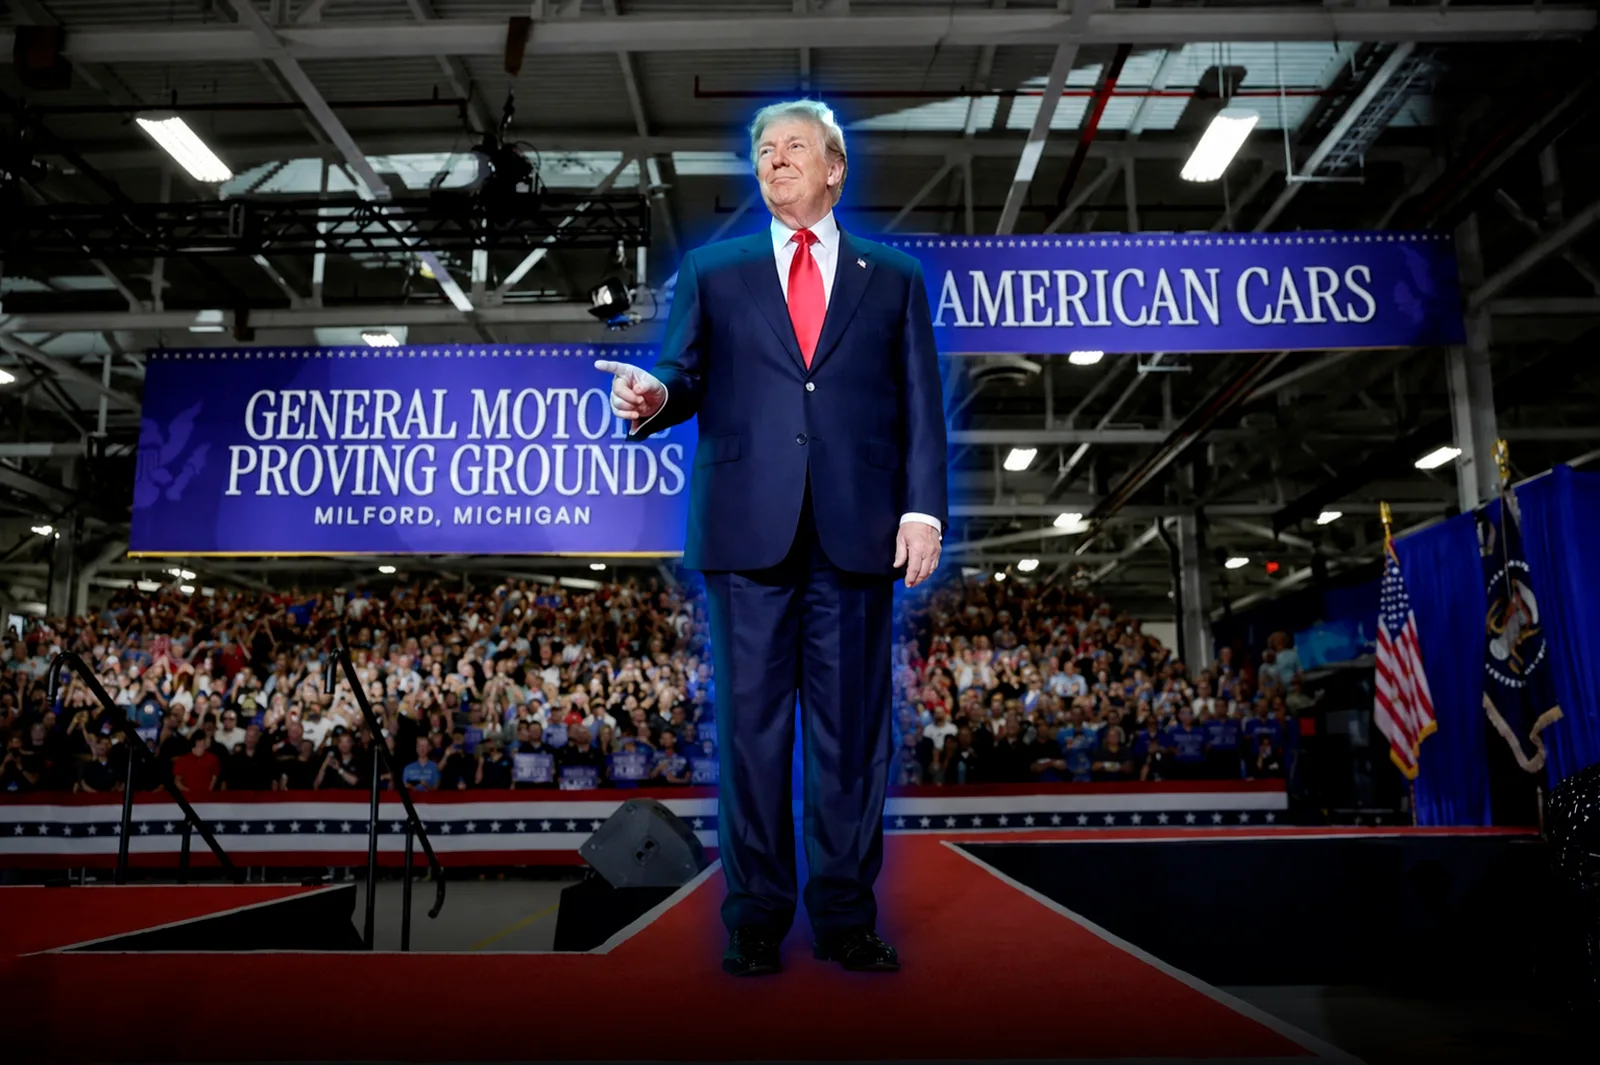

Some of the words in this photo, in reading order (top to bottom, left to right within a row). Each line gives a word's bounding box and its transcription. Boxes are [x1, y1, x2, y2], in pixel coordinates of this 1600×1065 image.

[932, 267, 1220, 327] AMERICAN
[1236, 264, 1377, 325] CARS
[245, 388, 458, 440] GENERAL
[467, 387, 671, 440] MOTO
[225, 444, 438, 496] PROVING
[450, 442, 685, 496] GROUNDS
[314, 506, 442, 527] MILFORD,
[453, 505, 591, 525] MICHIGAN
